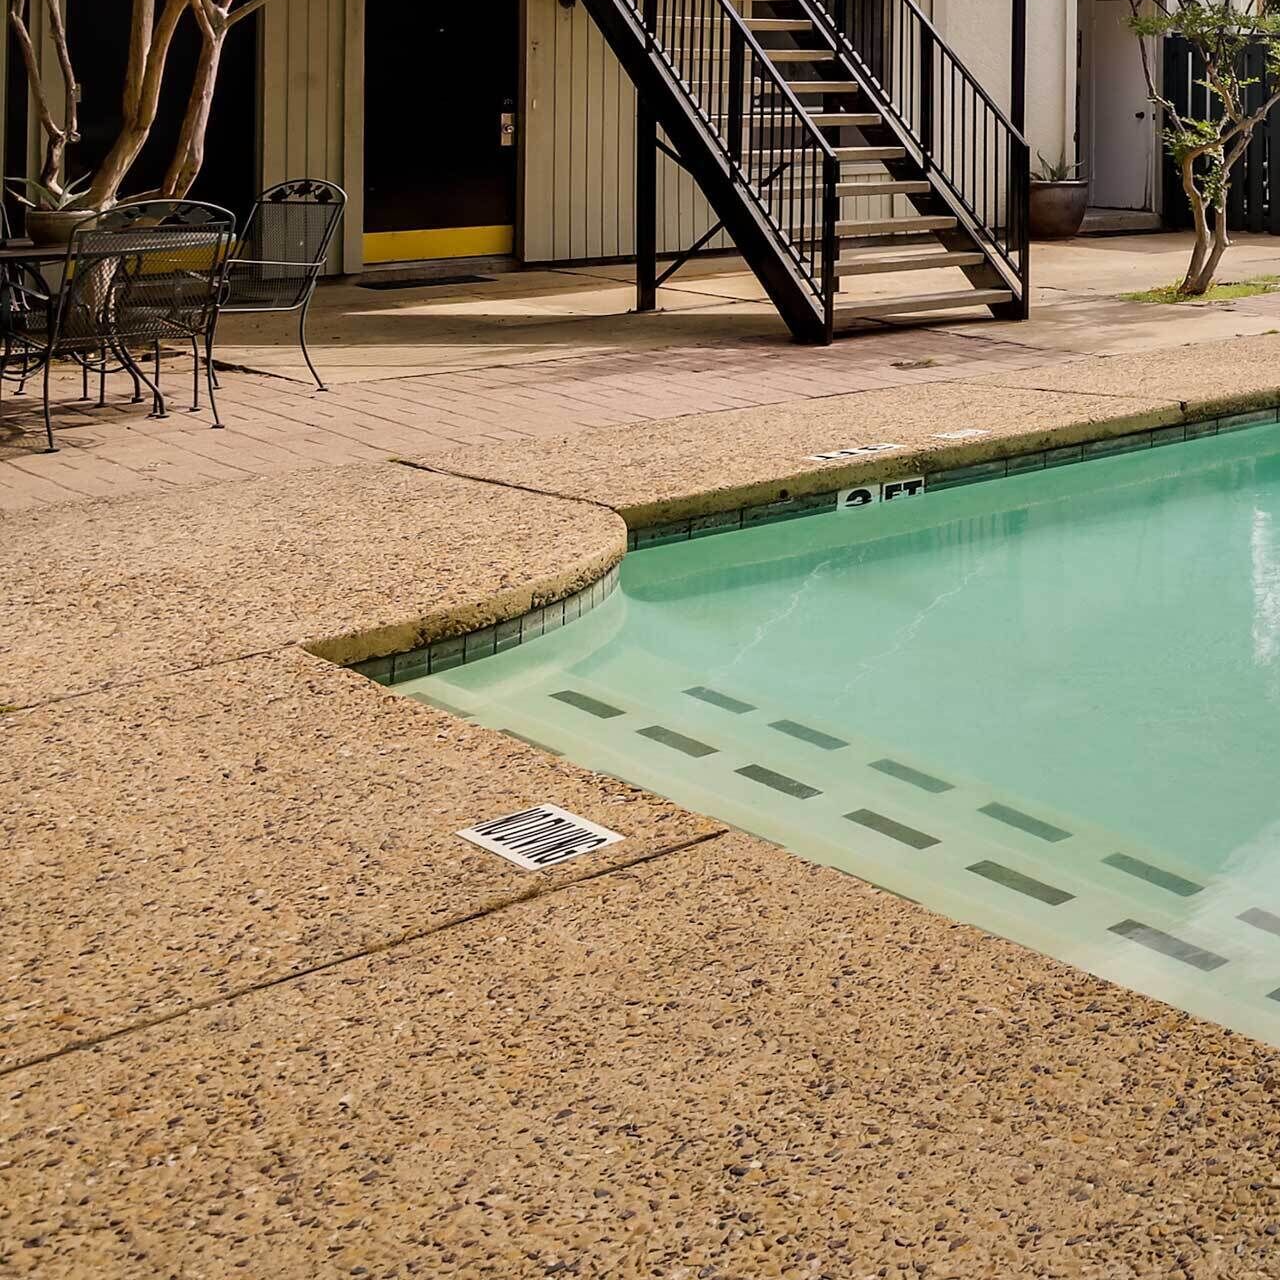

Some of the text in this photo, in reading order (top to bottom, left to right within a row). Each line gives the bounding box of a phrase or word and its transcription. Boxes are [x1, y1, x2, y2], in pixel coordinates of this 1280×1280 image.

[885, 480, 922, 500] FT
[471, 807, 608, 865] NO DIVING
